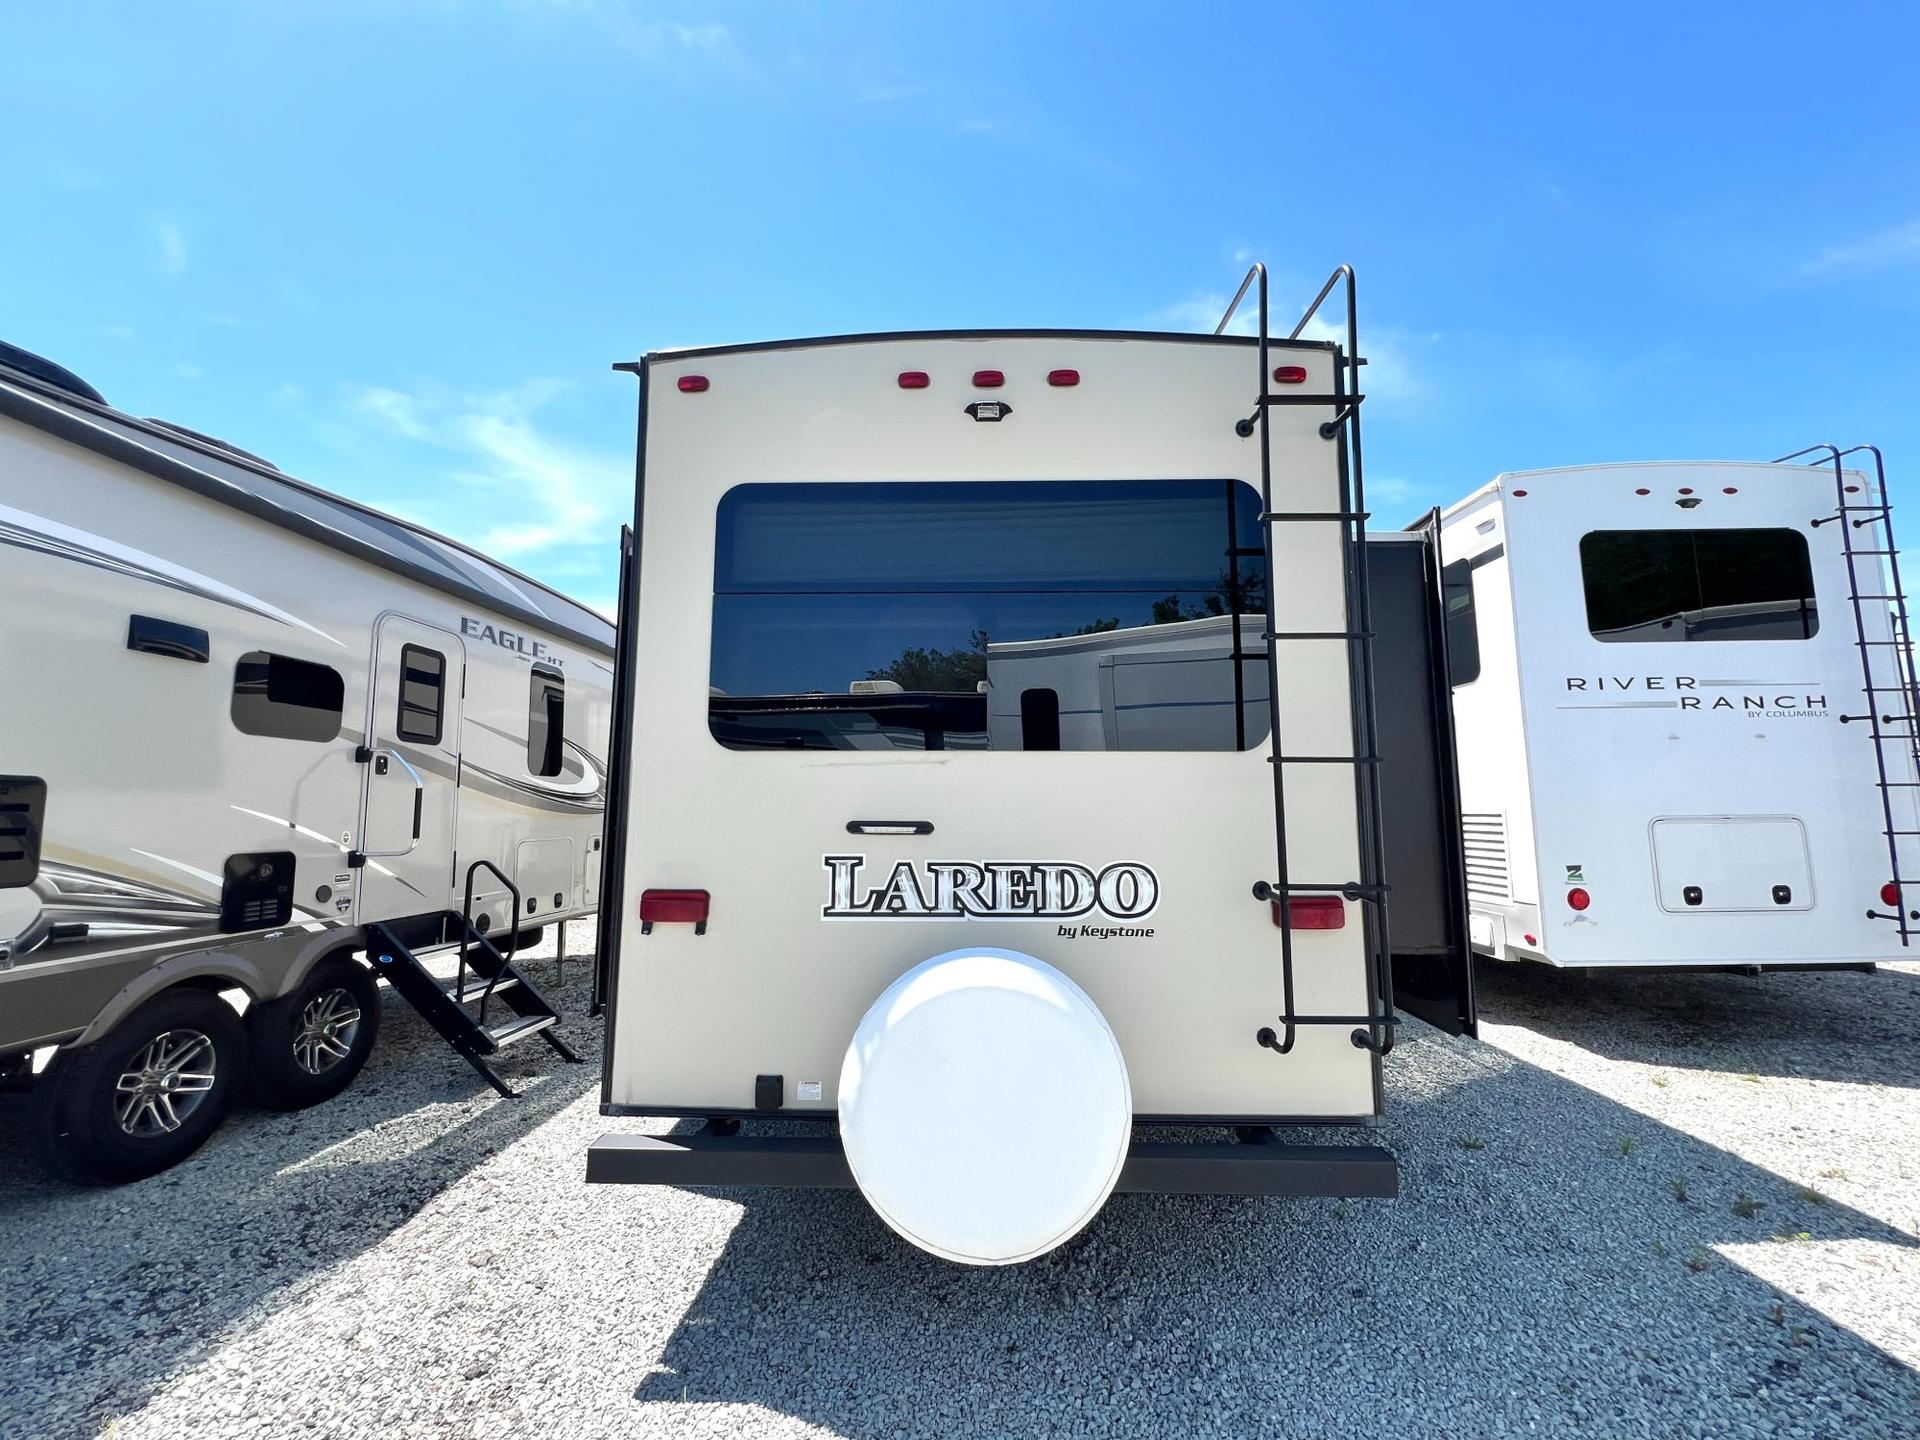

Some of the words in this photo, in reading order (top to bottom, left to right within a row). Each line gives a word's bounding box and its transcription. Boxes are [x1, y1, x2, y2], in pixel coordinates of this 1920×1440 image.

[461, 616, 547, 660] EAGLE
[547, 656, 565, 667] HT
[1566, 677, 1696, 690] RIVER
[1681, 695, 1827, 709] RANCH
[1765, 710, 1829, 718] COLUMBUS
[822, 855, 1160, 919] LAREDO
[1057, 925, 1077, 939] by
[1080, 925, 1155, 939] Keystone
